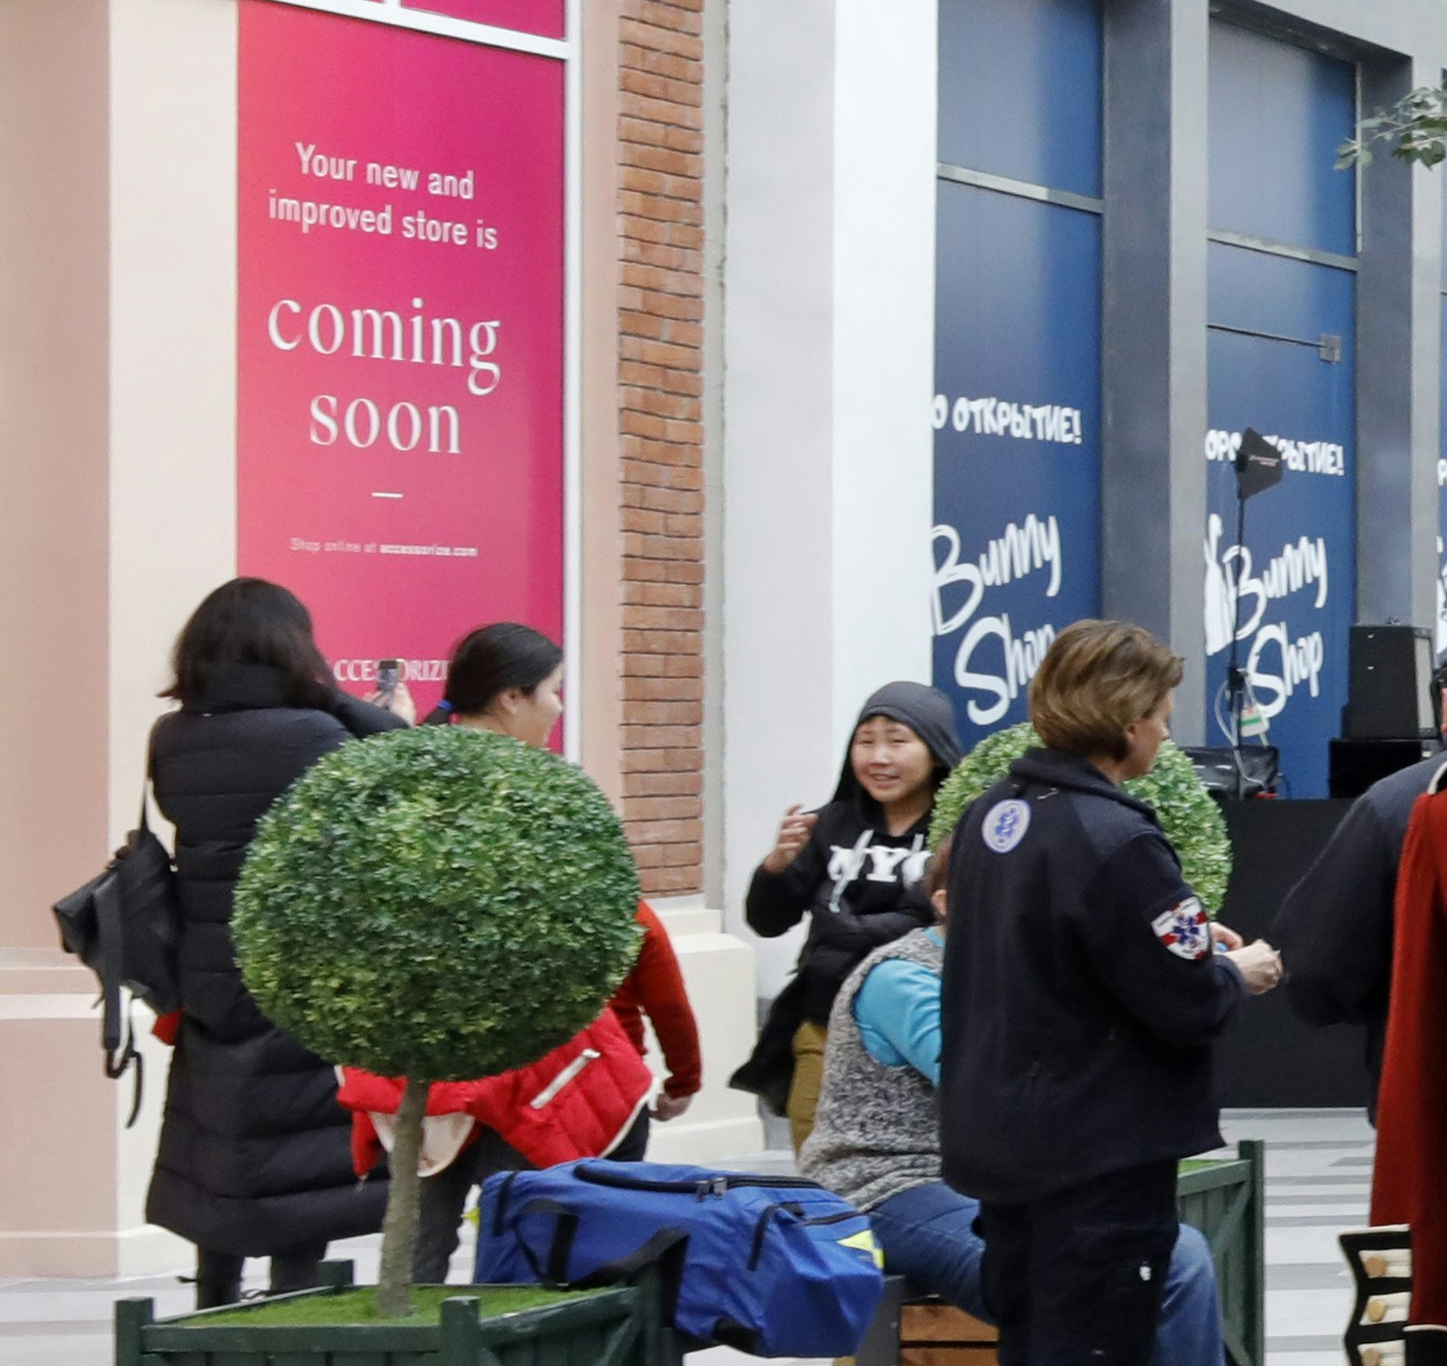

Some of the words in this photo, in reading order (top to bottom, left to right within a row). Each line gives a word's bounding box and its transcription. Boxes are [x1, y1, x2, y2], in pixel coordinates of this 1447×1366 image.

[295, 142, 357, 181] Your
[366, 162, 420, 190] new
[428, 170, 475, 199] and
[269, 189, 392, 234] improved
[402, 210, 468, 245] store
[476, 219, 498, 250] is
[268, 297, 500, 396] coming
[310, 395, 461, 454] soon
[952, 397, 1082, 444] ОТКРЫТИЕ!
[931, 513, 1062, 636] Bunny
[1222, 536, 1328, 641] Bunny
[1247, 621, 1324, 719] Shop
